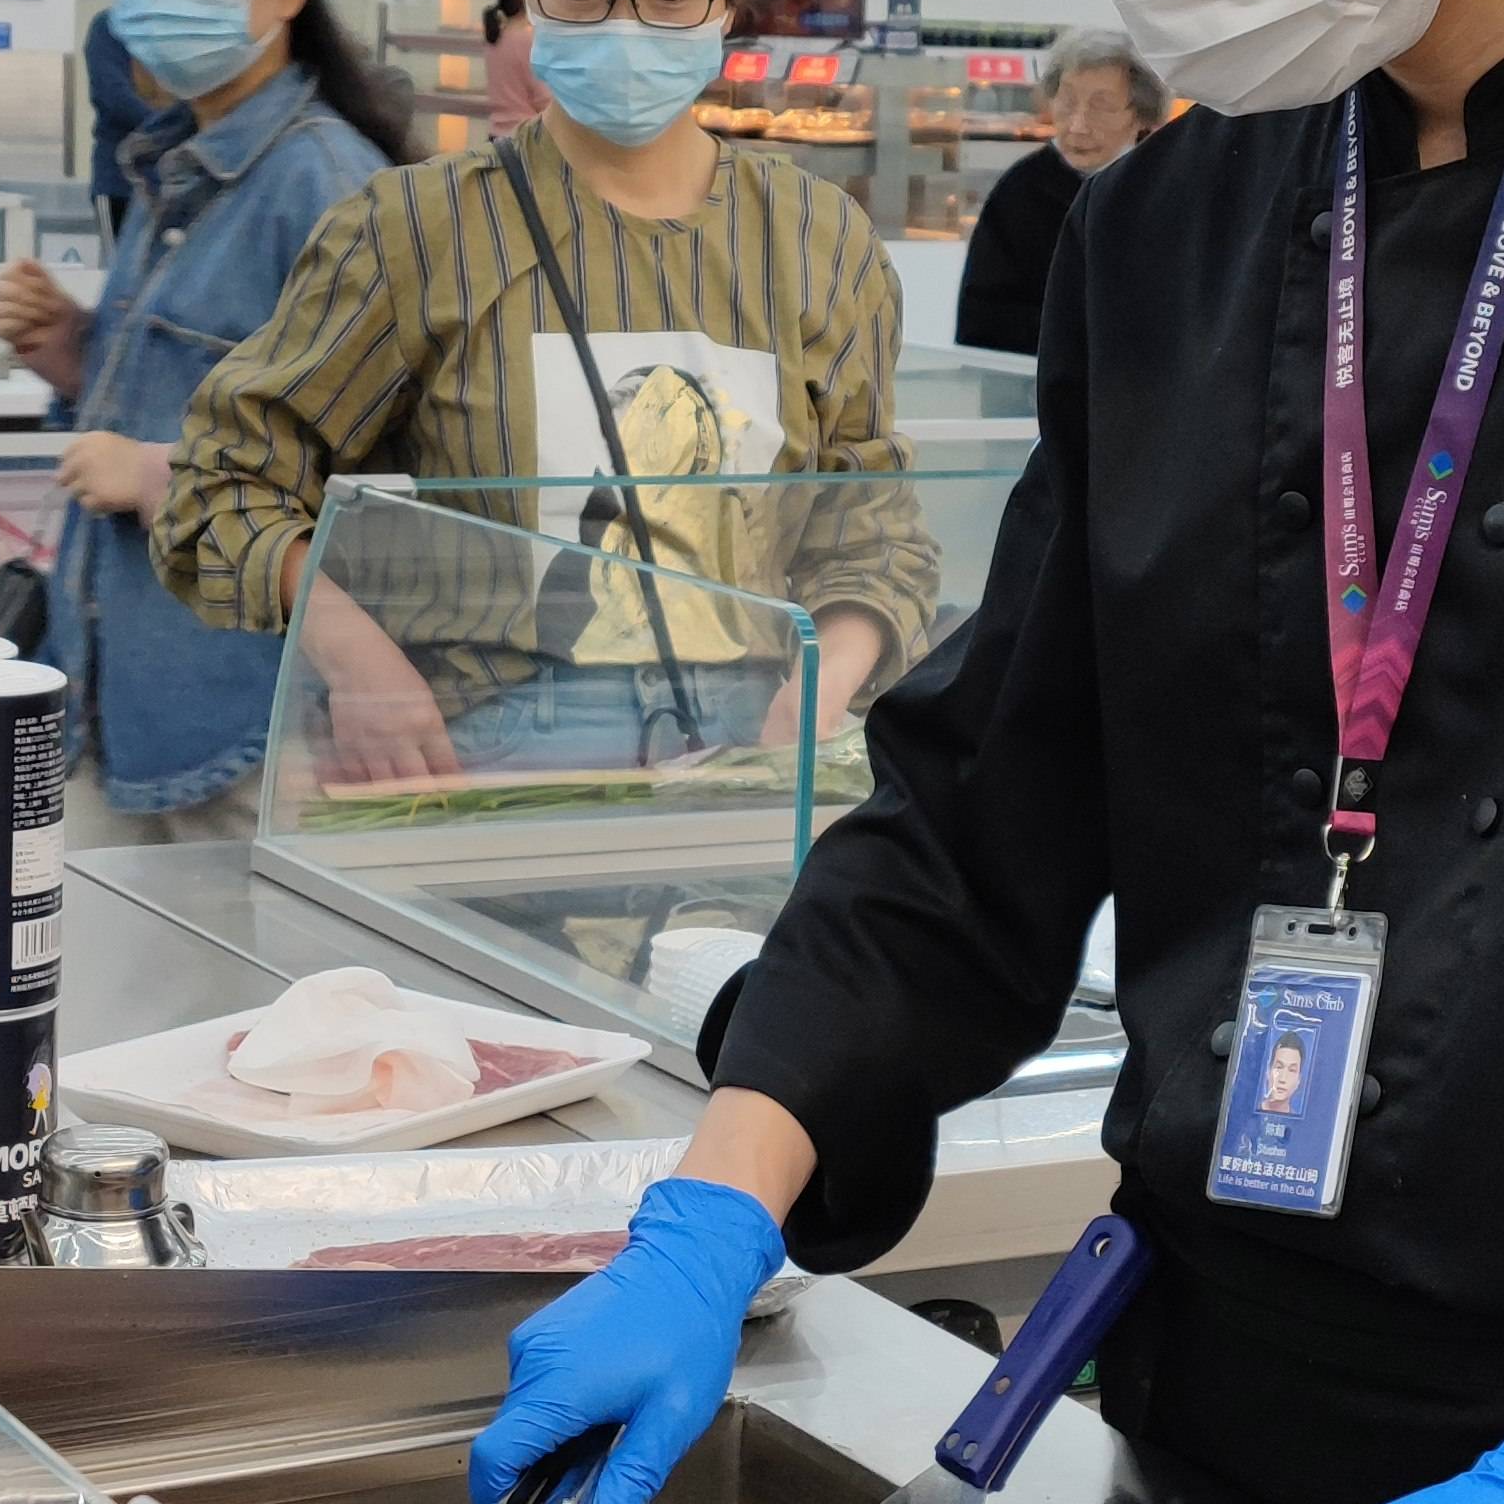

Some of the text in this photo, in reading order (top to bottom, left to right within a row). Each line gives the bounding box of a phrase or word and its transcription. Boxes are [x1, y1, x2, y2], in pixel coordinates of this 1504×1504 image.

[1342, 90, 1357, 261] ABOVE & BEYOND
[1480, 281, 1501, 298] &
[1336, 274, 1354, 388] 悦客无止境
[1456, 301, 1495, 392] BEYOND
[1415, 487, 1447, 542] Sam's
[1339, 524, 1359, 577] Sam's
[1357, 535, 1366, 563] CLUB
[1217, 1173, 1315, 1198] Life is better in the Club
